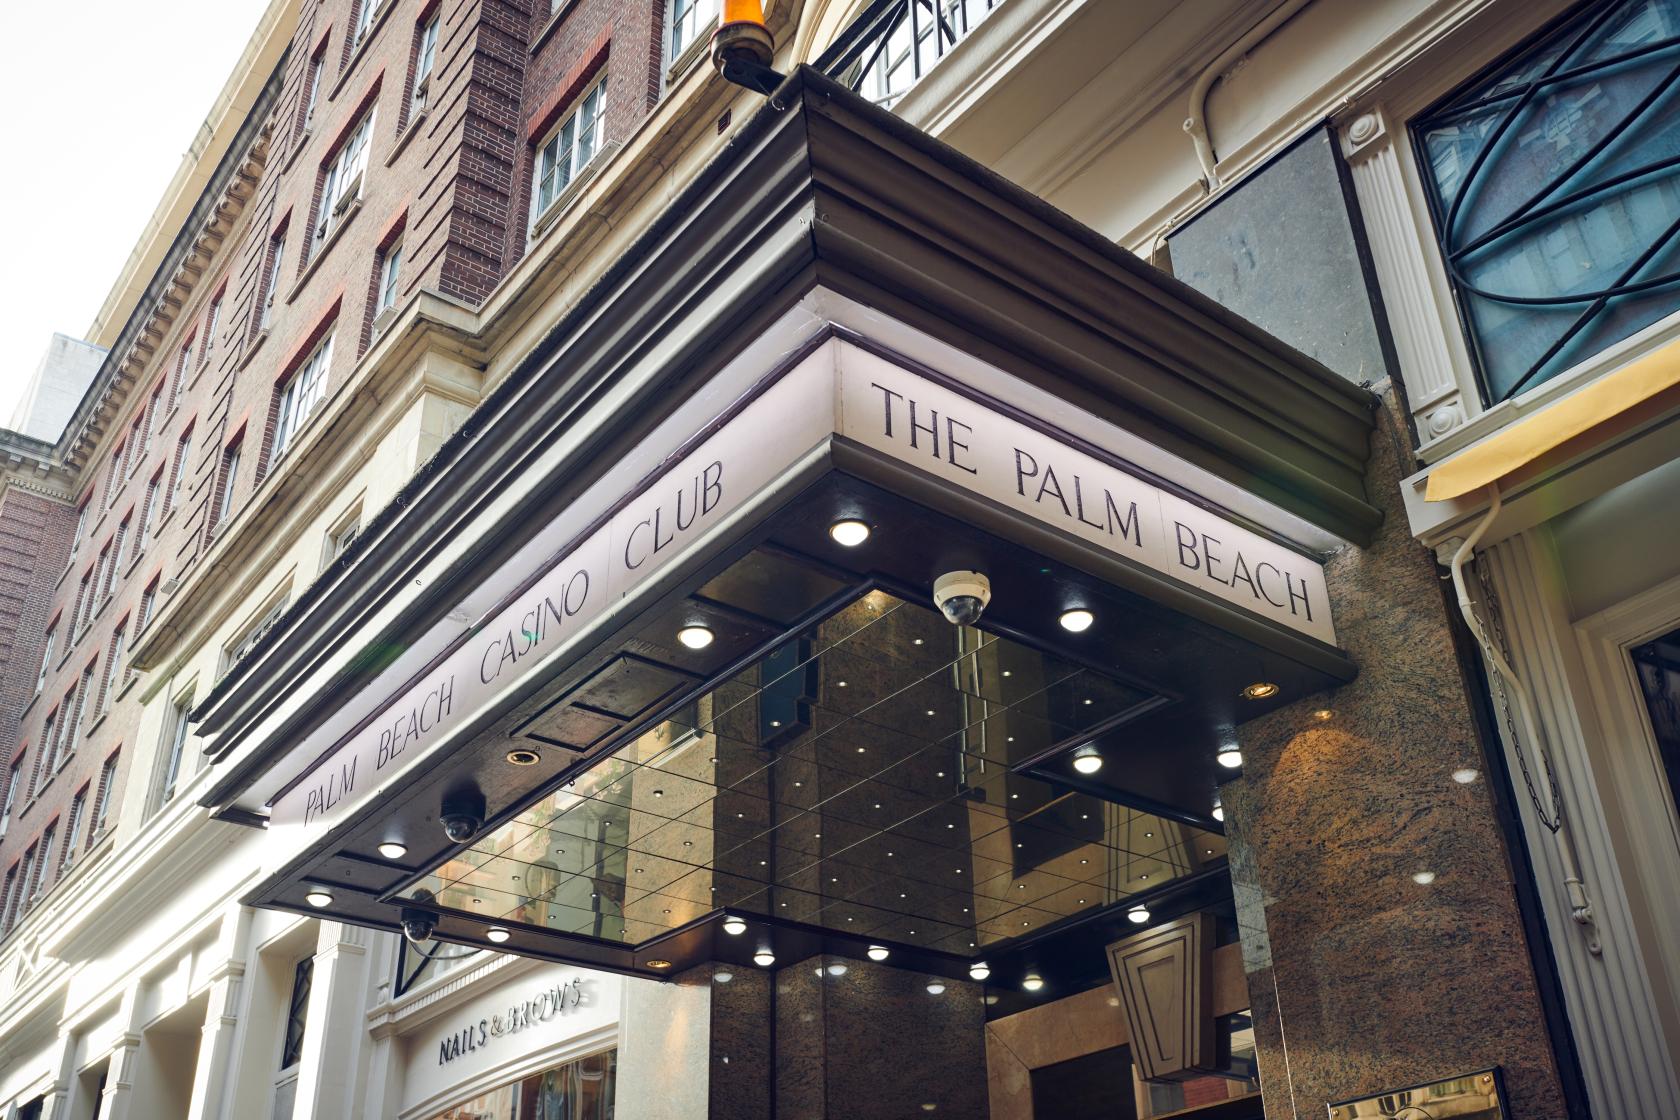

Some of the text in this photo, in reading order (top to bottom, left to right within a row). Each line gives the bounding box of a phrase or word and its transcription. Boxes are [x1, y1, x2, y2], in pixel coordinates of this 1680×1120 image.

[871, 382, 1313, 622] THE PALM BEACH
[304, 460, 723, 827] PALM BEACH CASINO CLUB
[438, 1018, 488, 1066] NAILS
